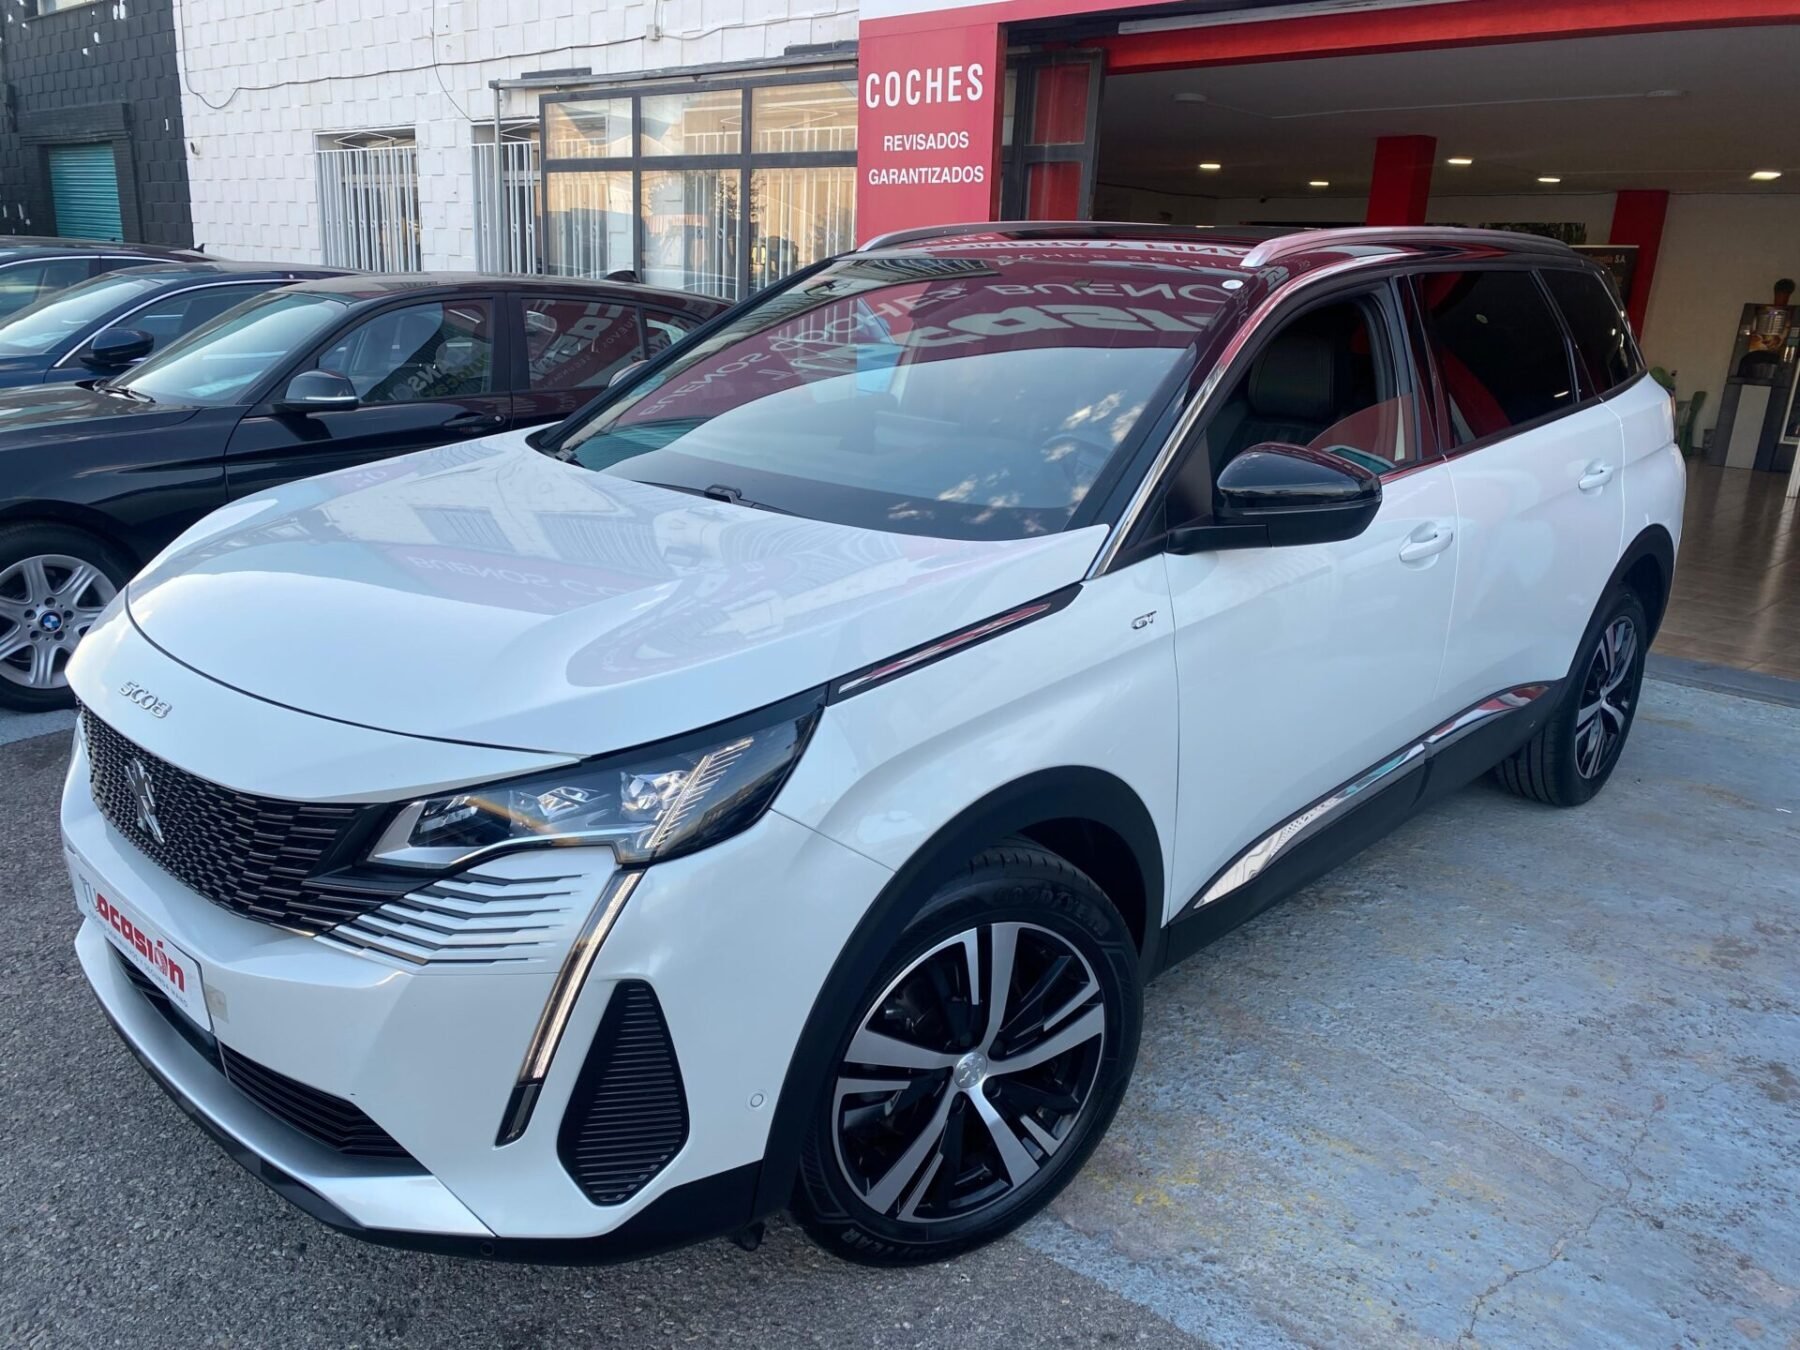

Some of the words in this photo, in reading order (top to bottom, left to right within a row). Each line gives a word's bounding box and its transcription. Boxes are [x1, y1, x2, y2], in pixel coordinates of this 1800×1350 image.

[865, 63, 984, 109] COCHES
[883, 131, 970, 152] REVISADOS
[868, 165, 985, 185] GARANTIZADOS
[1130, 610, 1157, 630] GT
[118, 680, 174, 719] 5008
